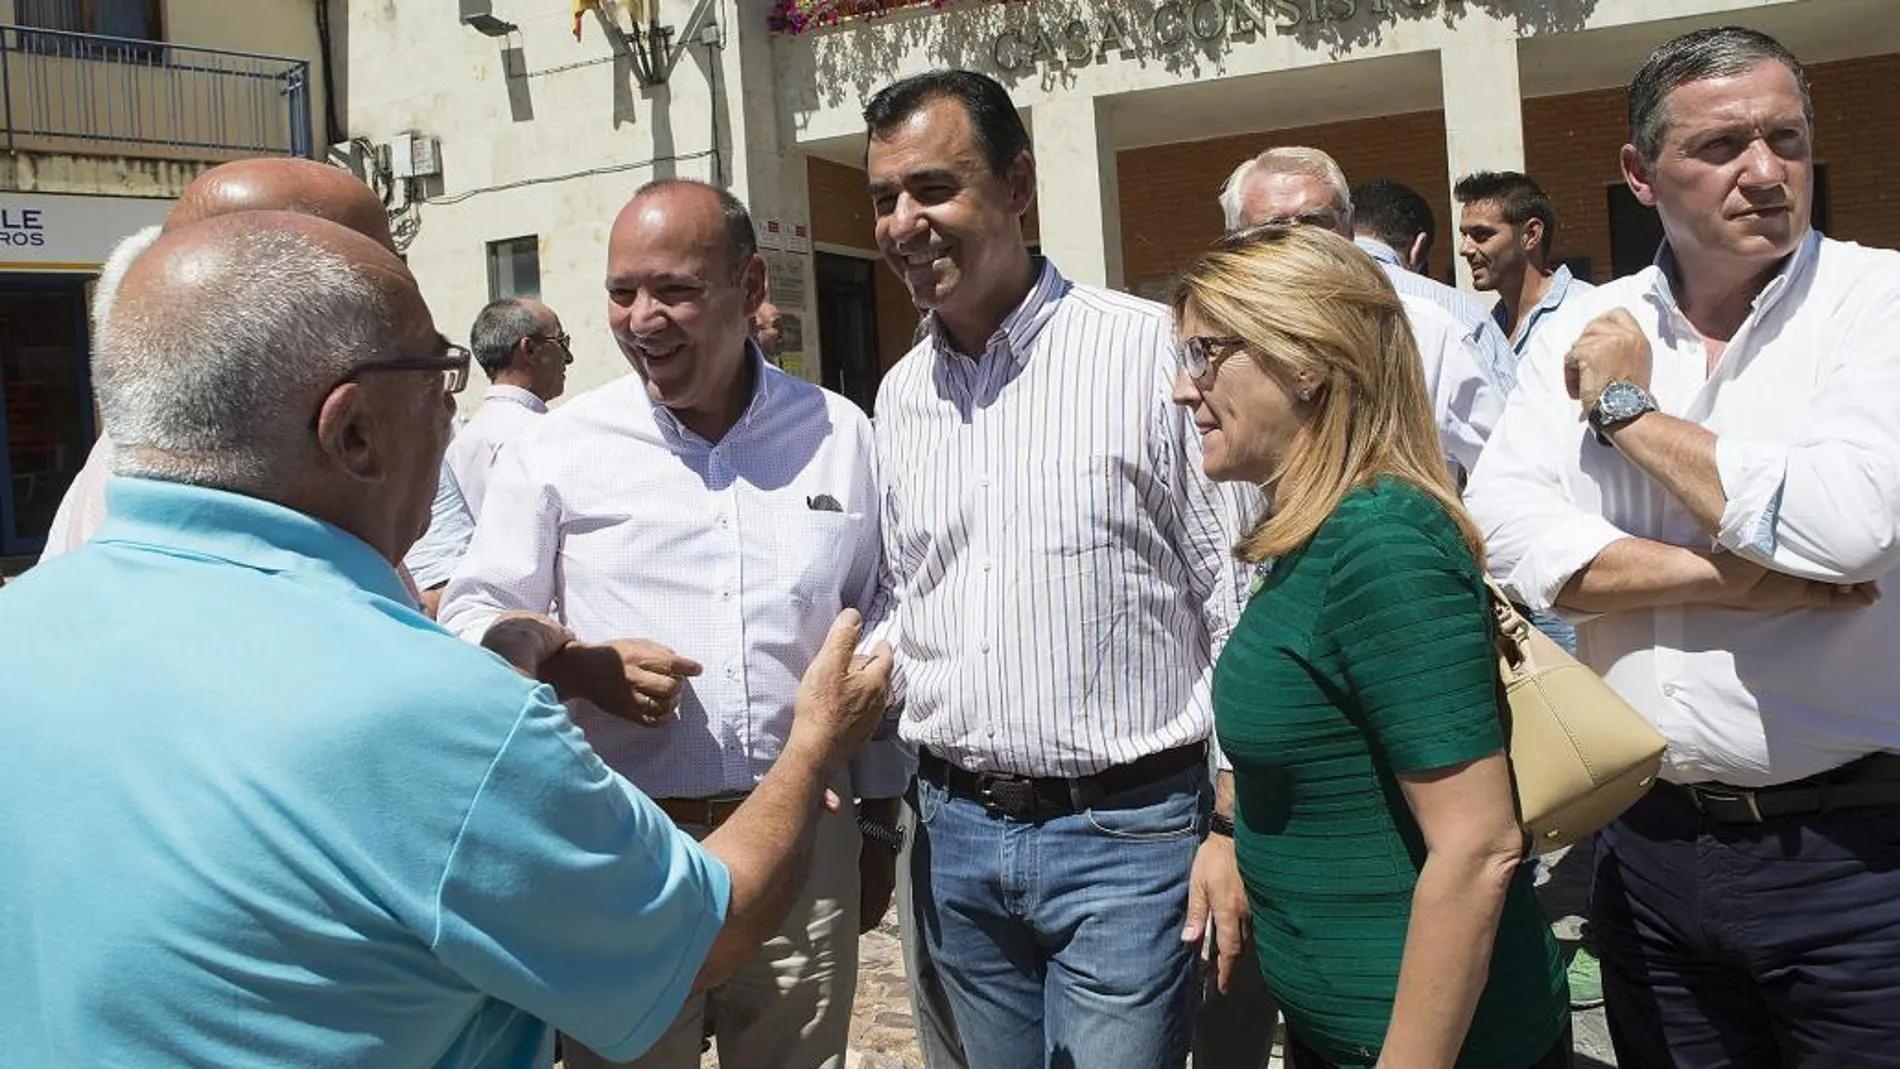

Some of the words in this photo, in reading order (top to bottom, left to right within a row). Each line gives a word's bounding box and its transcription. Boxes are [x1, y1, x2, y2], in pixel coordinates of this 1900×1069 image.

[994, 11, 1133, 70] CASA
[1151, 0, 1431, 43] CONSI
[2, 209, 43, 229] LE
[0, 231, 44, 246] ROS
